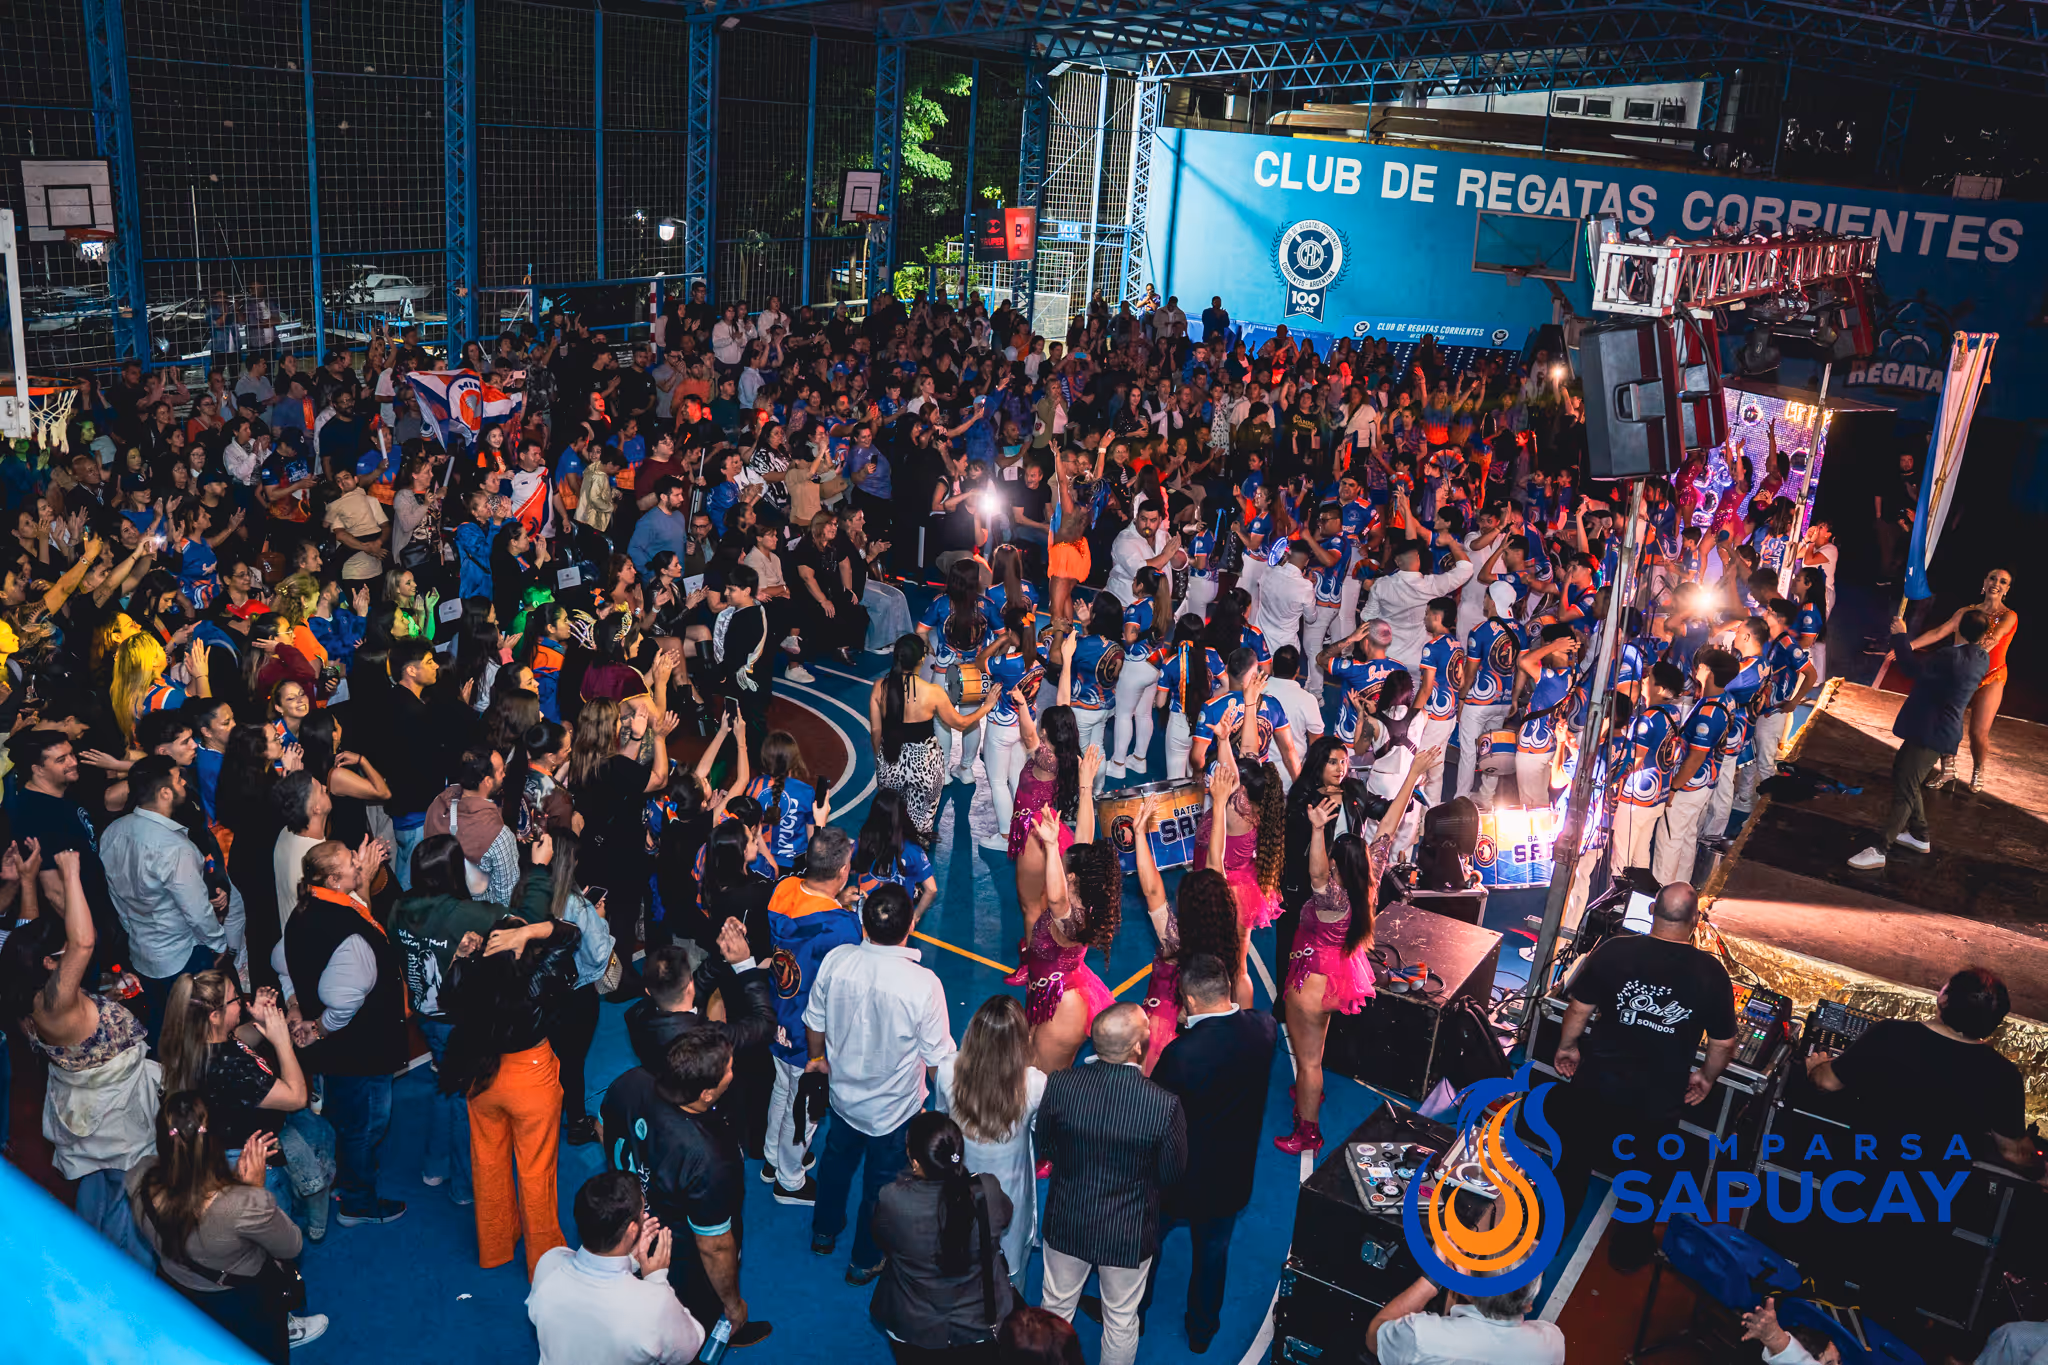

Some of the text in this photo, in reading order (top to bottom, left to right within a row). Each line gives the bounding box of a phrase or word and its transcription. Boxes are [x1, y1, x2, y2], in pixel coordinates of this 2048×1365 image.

[1253, 150, 2024, 263] CLUB DE REGATAS CORRIENTES
[1299, 221, 1321, 230] REGATAS
[1320, 225, 1341, 251] CORRIENTES
[1291, 290, 1321, 307] 100
[1295, 304, 1315, 314] AÑOS
[1376, 322, 1396, 332] CLUB
[1396, 323, 1406, 332] DE
[1407, 323, 1439, 334] REGATAS
[1440, 326, 1485, 337] CORRIENTES
[1848, 361, 1944, 393] REGATA
[1173, 803, 1202, 817] BATER
[1636, 1018, 1676, 1034] SONIDOS
